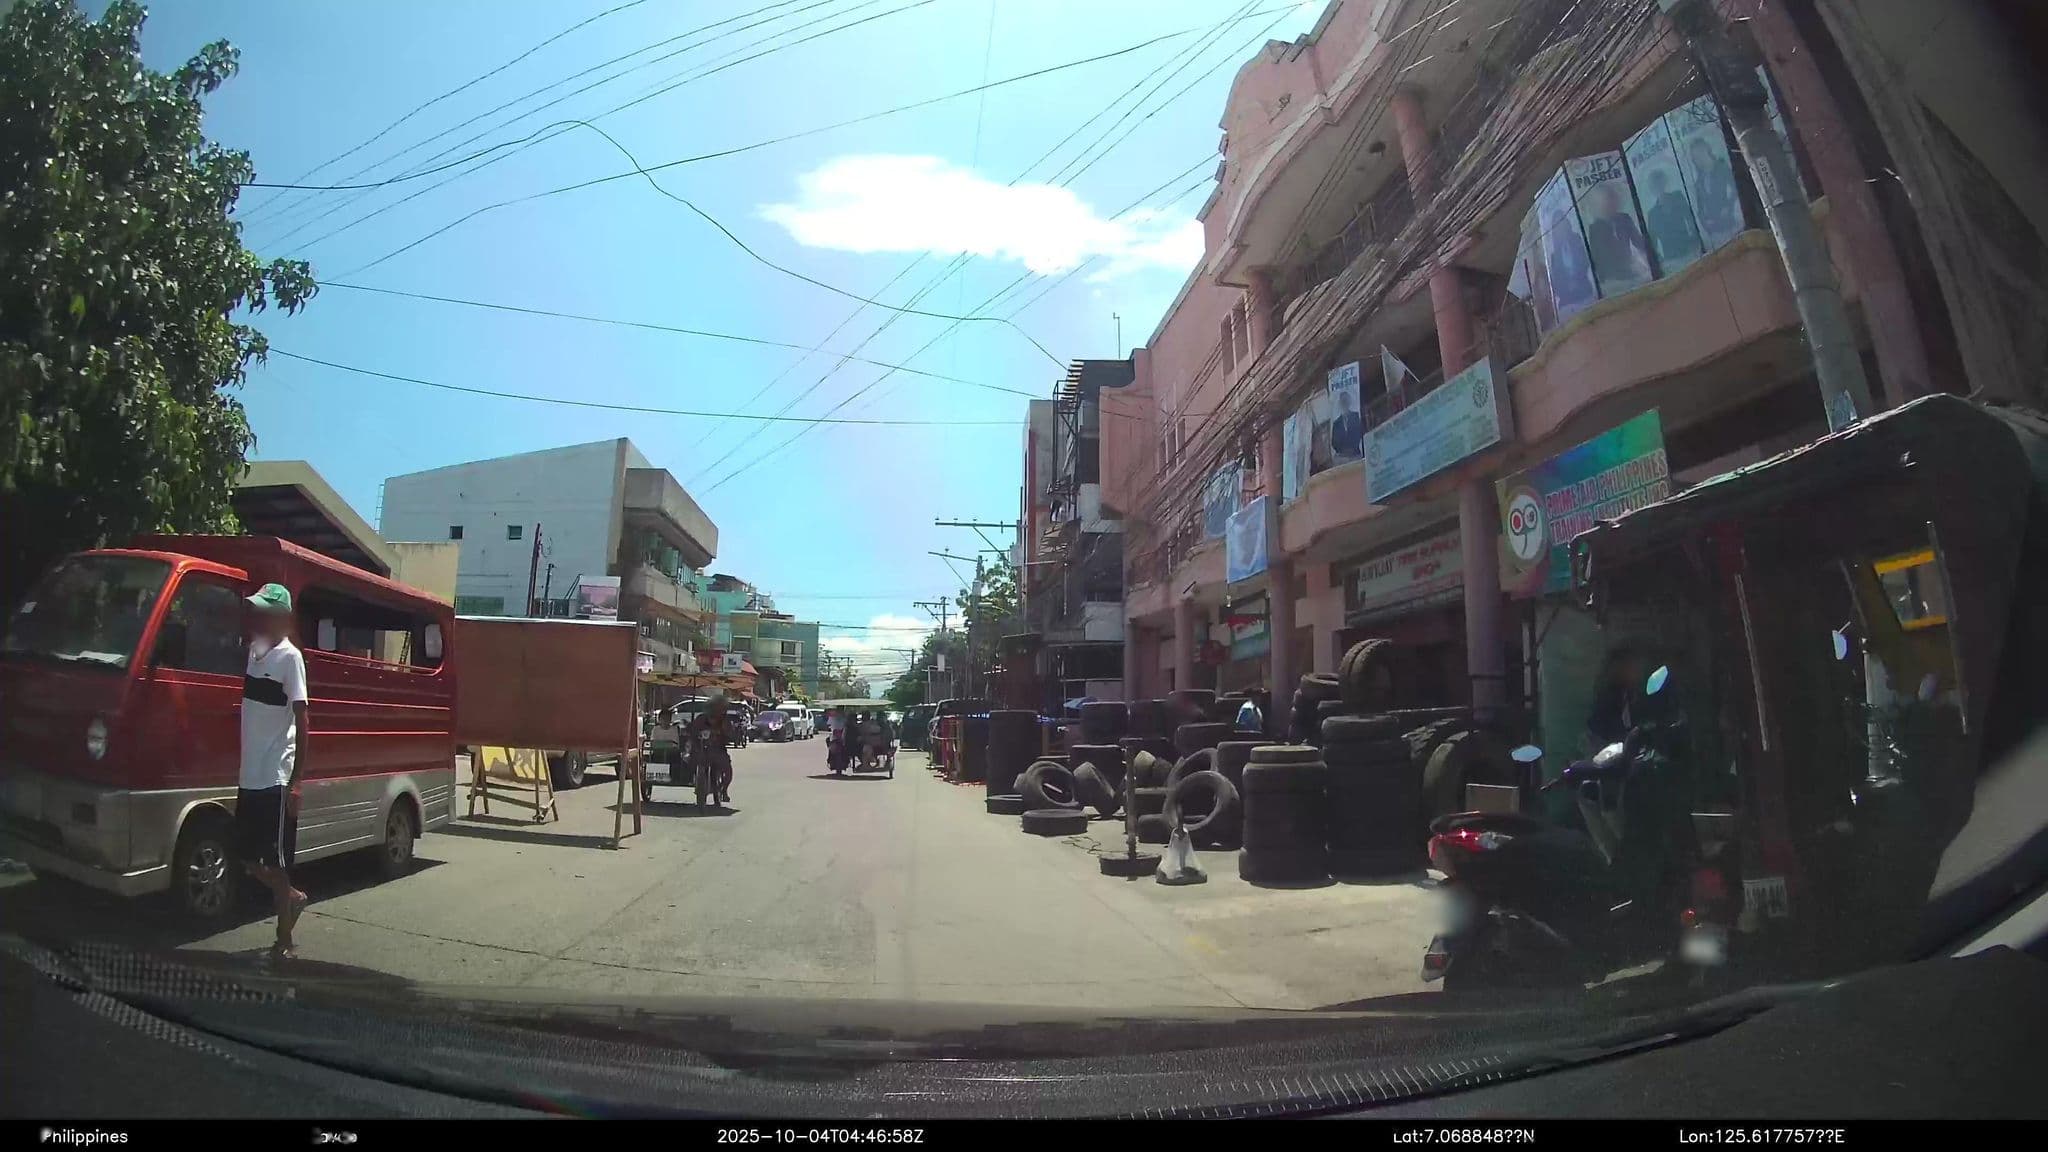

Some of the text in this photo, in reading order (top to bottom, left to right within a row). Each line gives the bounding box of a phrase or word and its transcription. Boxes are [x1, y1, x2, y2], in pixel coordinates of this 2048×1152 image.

[1575, 168, 1622, 188] PASSER
[1598, 448, 1668, 500] PHILIPPINES
[1551, 509, 1593, 545] TRAINING
